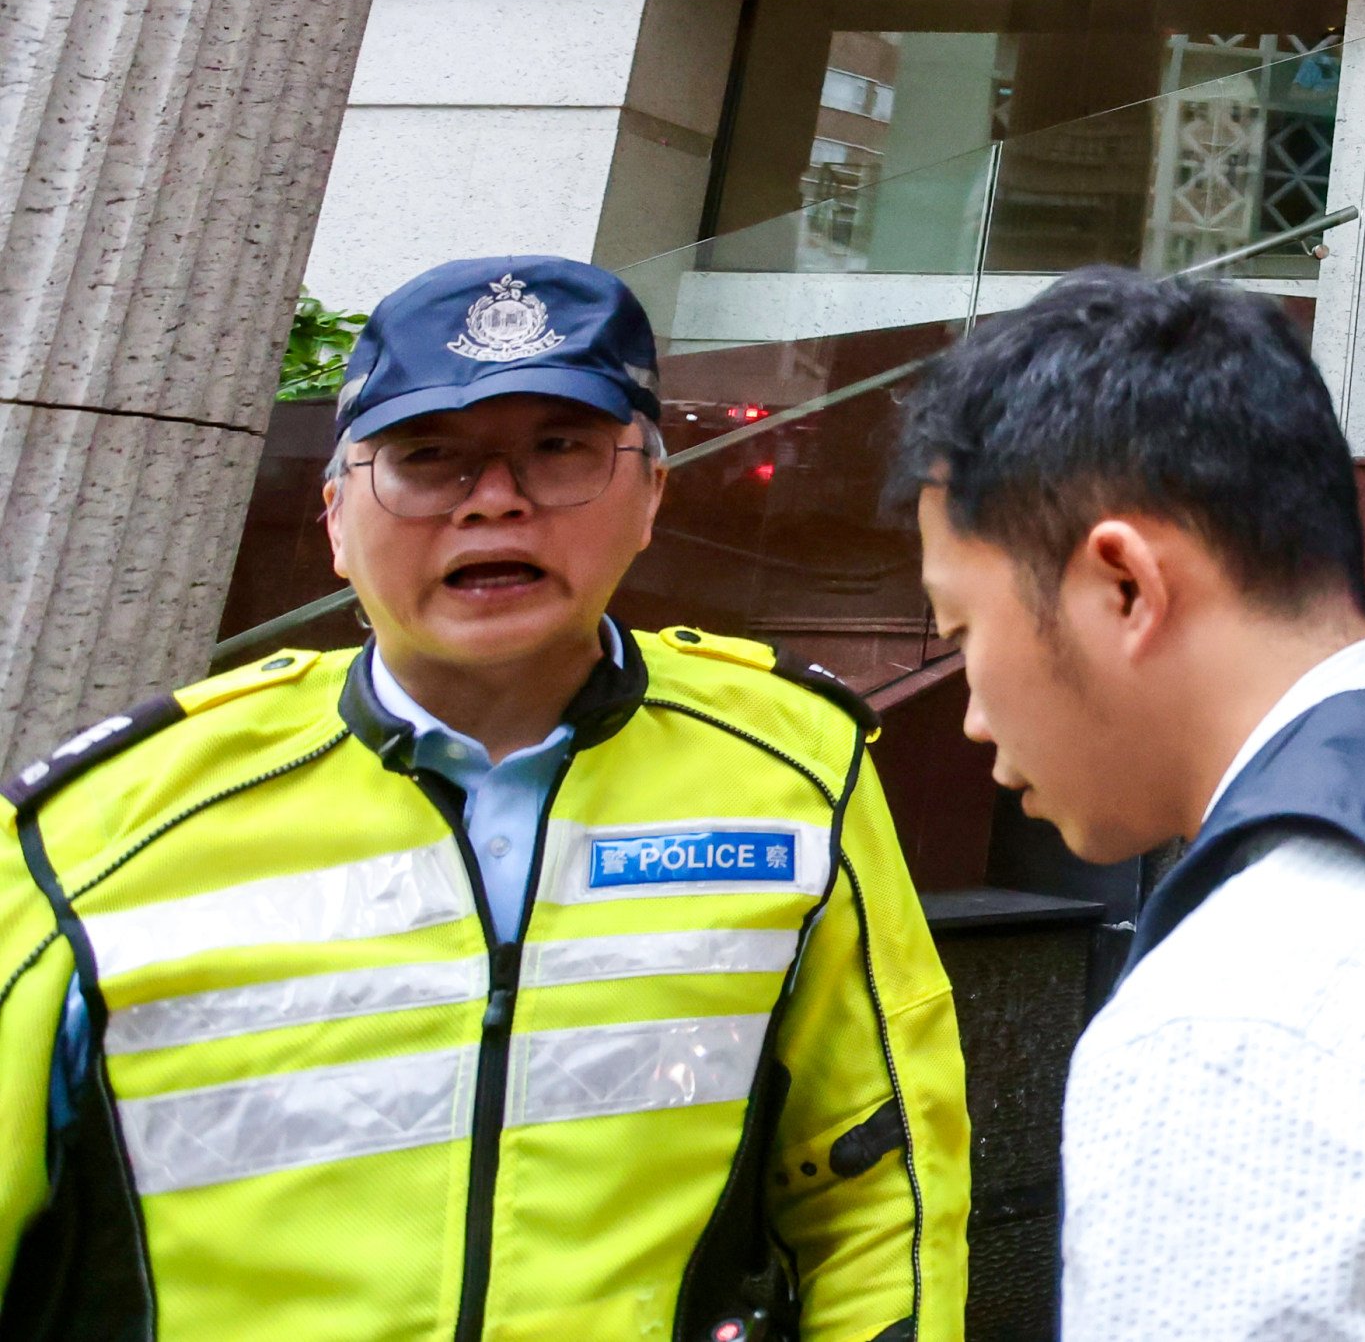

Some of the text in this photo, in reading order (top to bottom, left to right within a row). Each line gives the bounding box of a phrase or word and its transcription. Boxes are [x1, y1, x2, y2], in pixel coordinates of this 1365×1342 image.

[600, 844, 789, 875] 警 POLICE 察
